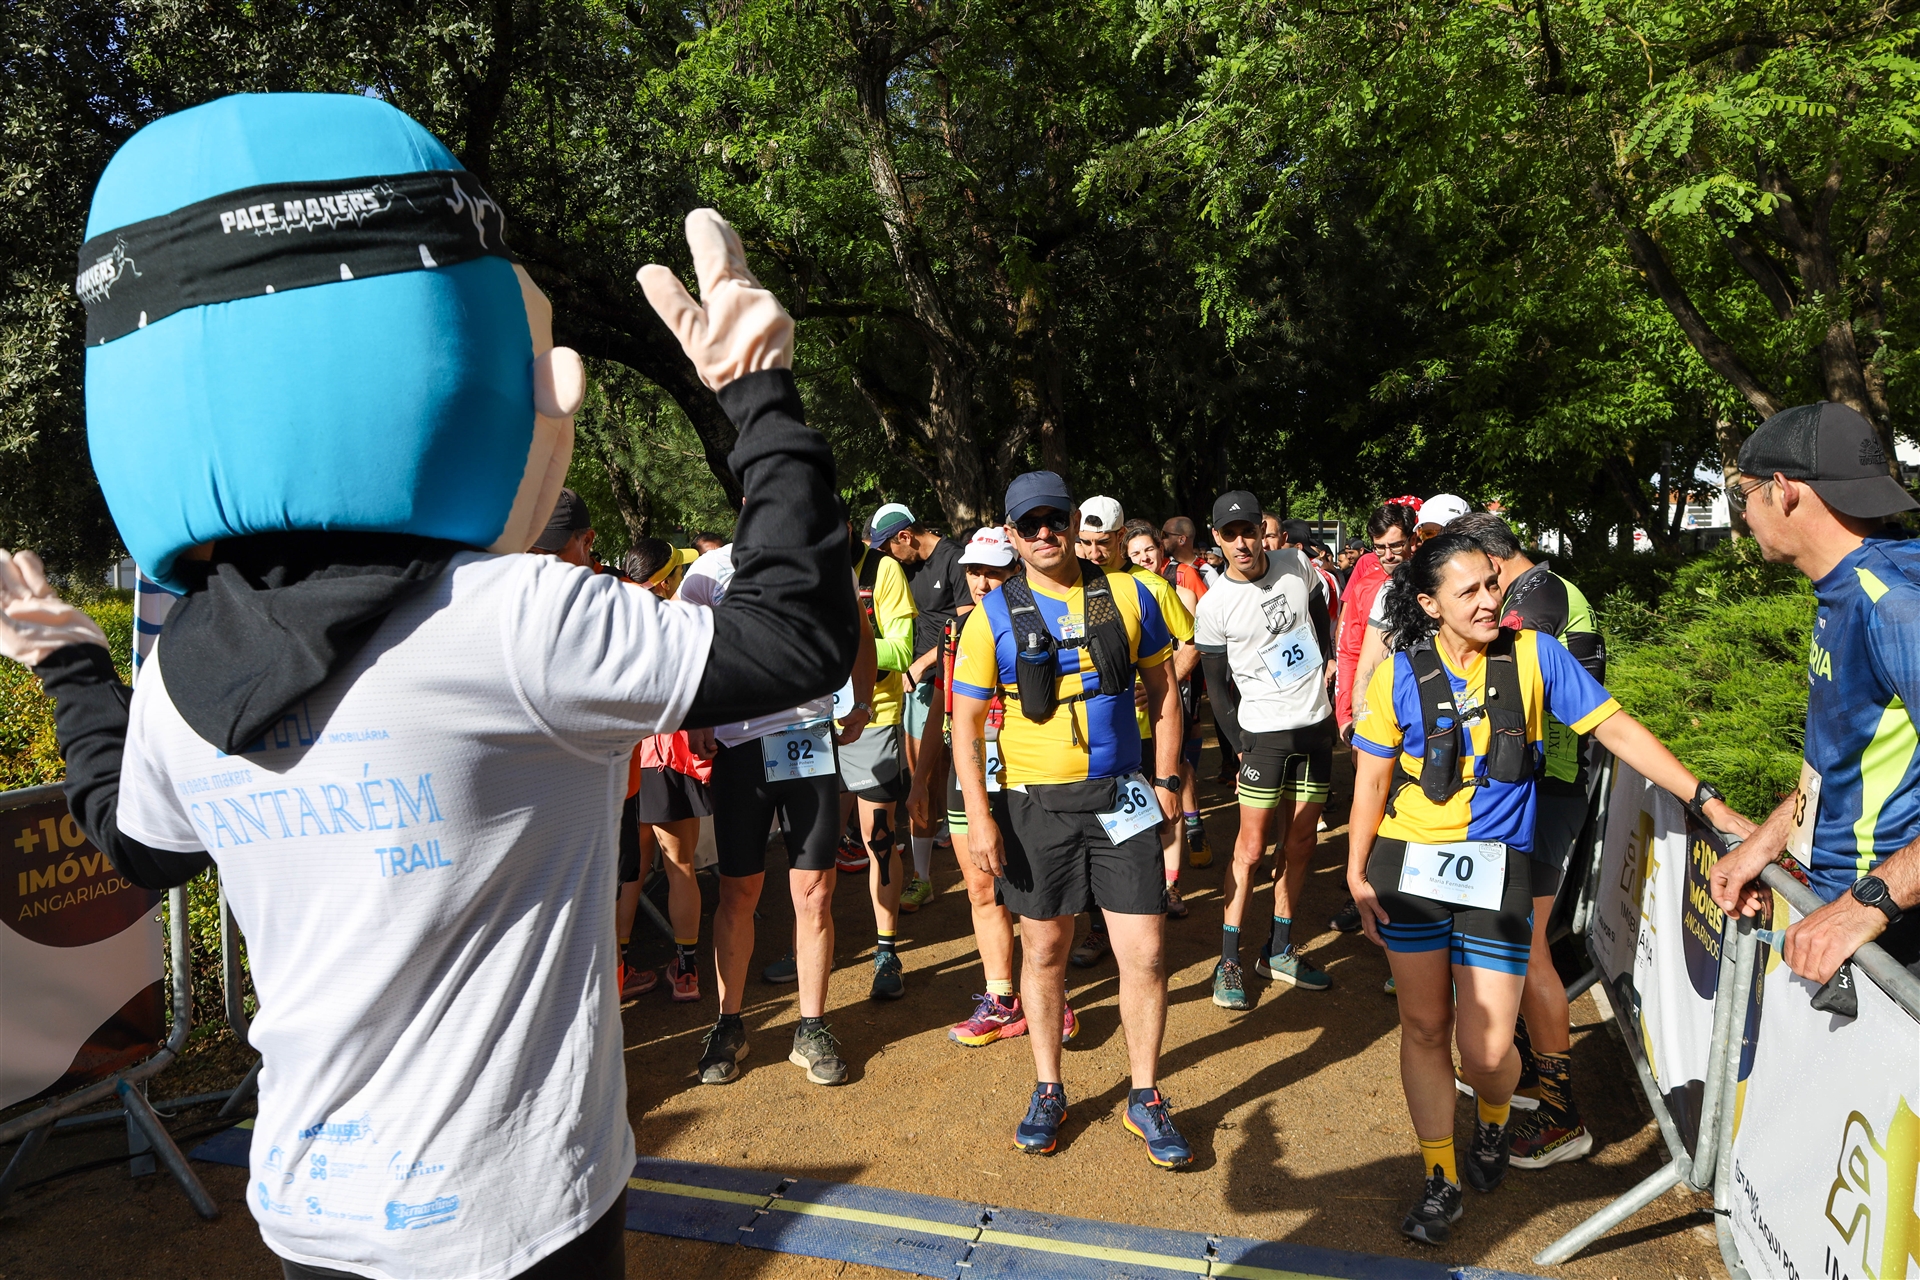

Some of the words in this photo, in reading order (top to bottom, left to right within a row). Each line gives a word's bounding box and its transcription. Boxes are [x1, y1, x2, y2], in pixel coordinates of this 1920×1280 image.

[1282, 643, 1305, 668] 25
[1809, 630, 1833, 681] RIA
[329, 729, 390, 744] IMOBILIÁRIA
[786, 739, 814, 761] 82
[190, 762, 446, 850] SANTARÉM
[1117, 786, 1148, 815] 36
[374, 838, 453, 878] TRAIL
[1437, 850, 1474, 882] 70
[1429, 876, 1445, 886] Maria
[1445, 880, 1475, 891] Fernandes
[1689, 879, 1724, 936] IMÓVEIS
[1683, 910, 1721, 961] ANGARIADOS
[1531, 1149, 1545, 1161] LA
[1758, 1215, 1781, 1261] AQUI
